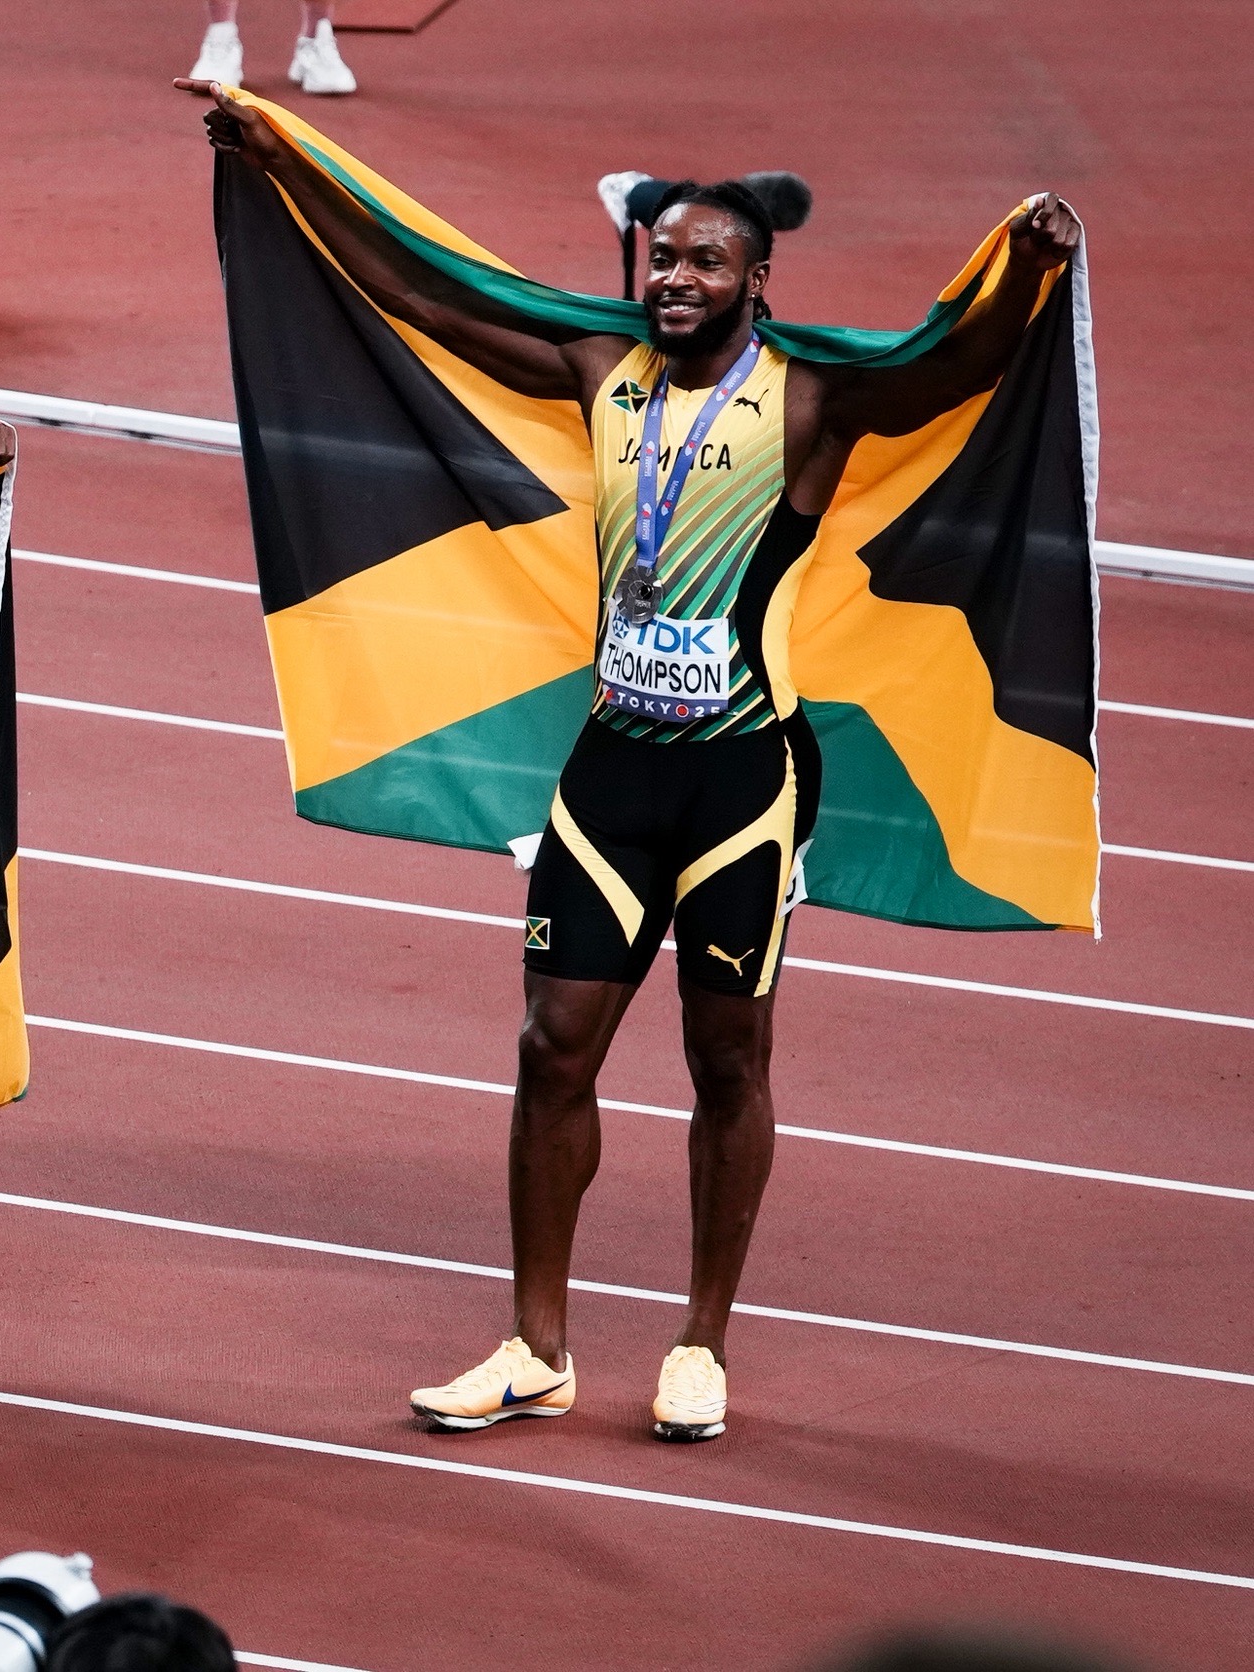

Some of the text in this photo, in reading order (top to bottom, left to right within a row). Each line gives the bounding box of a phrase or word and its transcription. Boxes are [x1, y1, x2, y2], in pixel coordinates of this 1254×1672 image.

[618, 438, 732, 472] JMCA
[637, 617, 716, 655] TDK
[604, 642, 721, 695] THOMPSON
